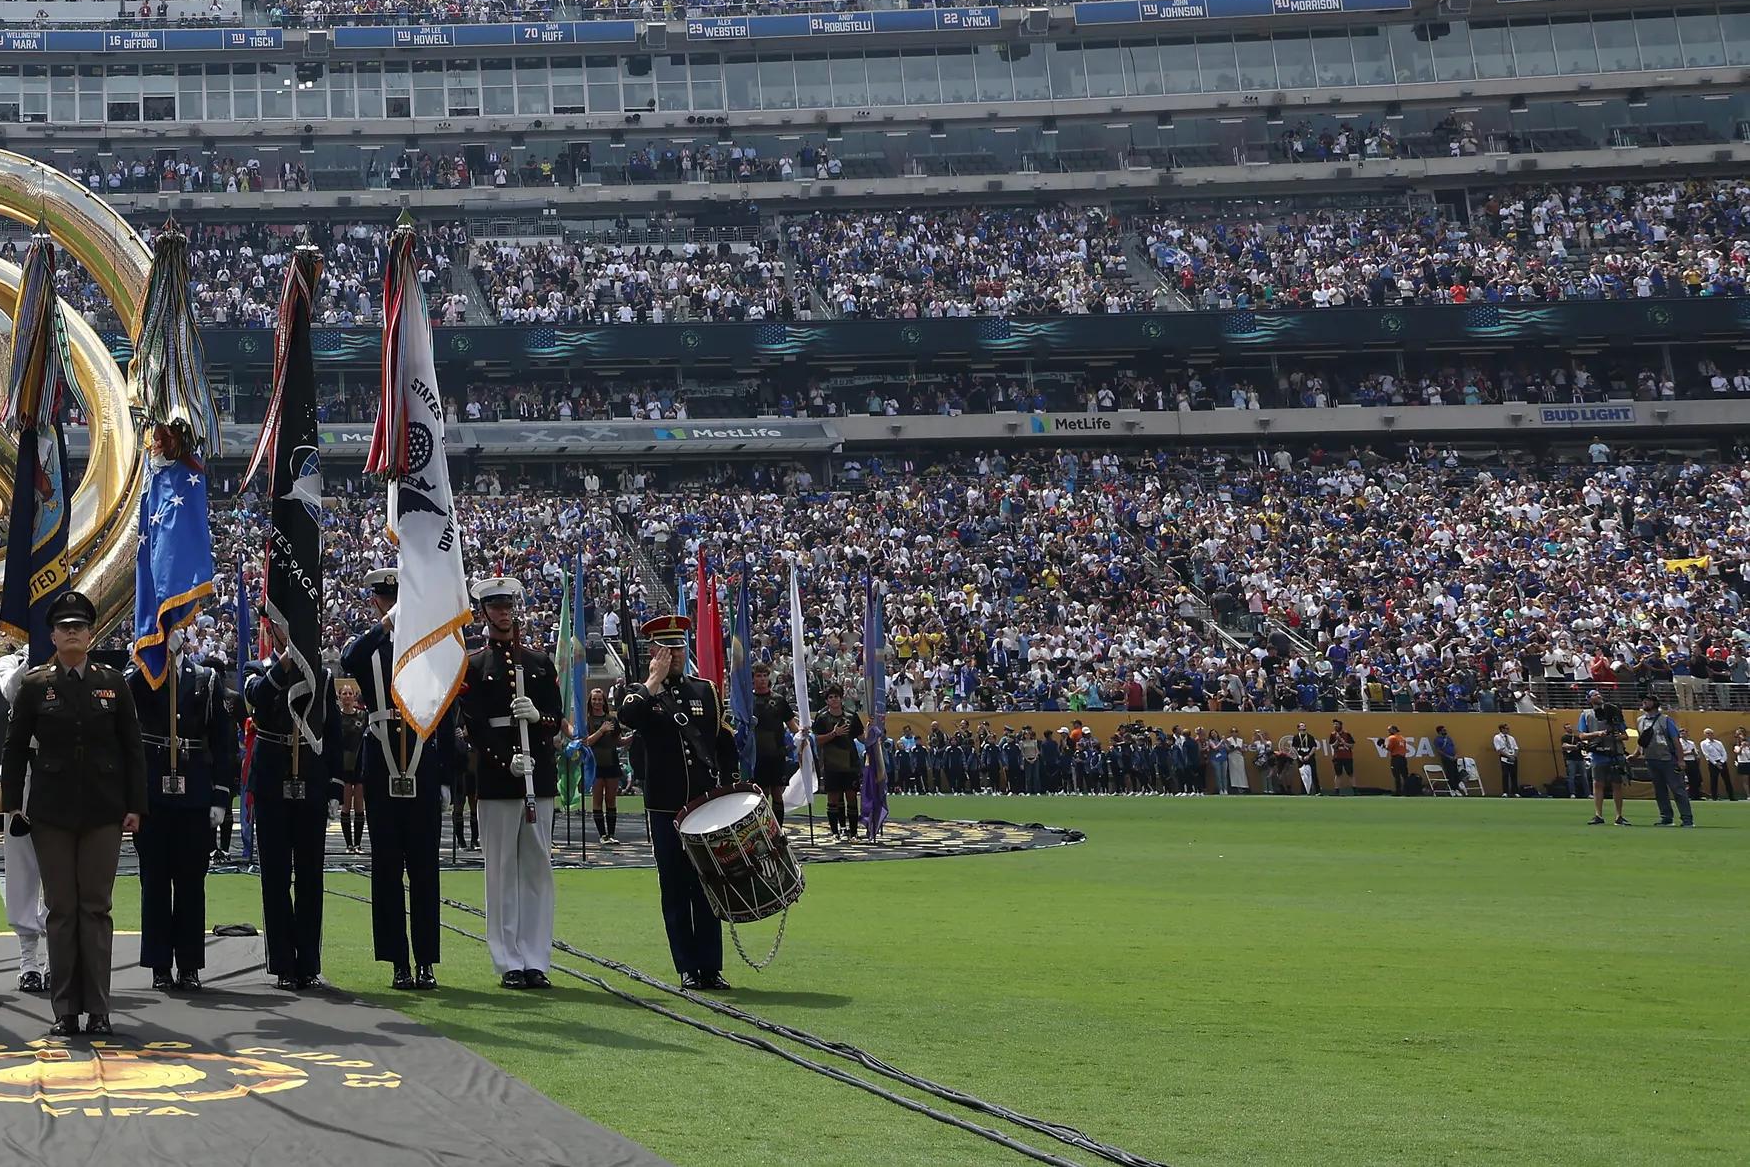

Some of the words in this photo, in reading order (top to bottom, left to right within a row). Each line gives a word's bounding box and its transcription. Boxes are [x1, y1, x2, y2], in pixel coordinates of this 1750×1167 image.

[838, 13, 854, 21] ANDY
[1159, 6, 1203, 18] JOHNSON
[716, 18, 732, 26] ALEX
[943, 13, 958, 24] 22
[962, 16, 991, 27] LYNCH
[689, 23, 703, 34] 29
[811, 19, 824, 30] 81
[824, 21, 871, 32] ROBUSTELLI
[130, 31, 150, 39] FRANK
[524, 27, 538, 38] 70
[541, 31, 564, 42] HUFF
[703, 26, 747, 37] WEBSTER
[12, 39, 38, 49] MARA
[109, 36, 121, 46] 16
[123, 38, 158, 49] GIFFORD
[249, 37, 274, 47] TISCH
[413, 34, 449, 45] HOWELL
[410, 377, 443, 421] STATES
[1543, 410, 1579, 422] BUD
[1581, 408, 1631, 421] LIGHT
[1055, 418, 1111, 430] MetLife
[692, 428, 782, 438] MetLife
[271, 526, 292, 555] TES
[290, 559, 319, 600] PACE
[30, 570, 56, 598] ITED
[1367, 737, 1435, 757] VSA
[40, 1104, 199, 1118] FIFA
